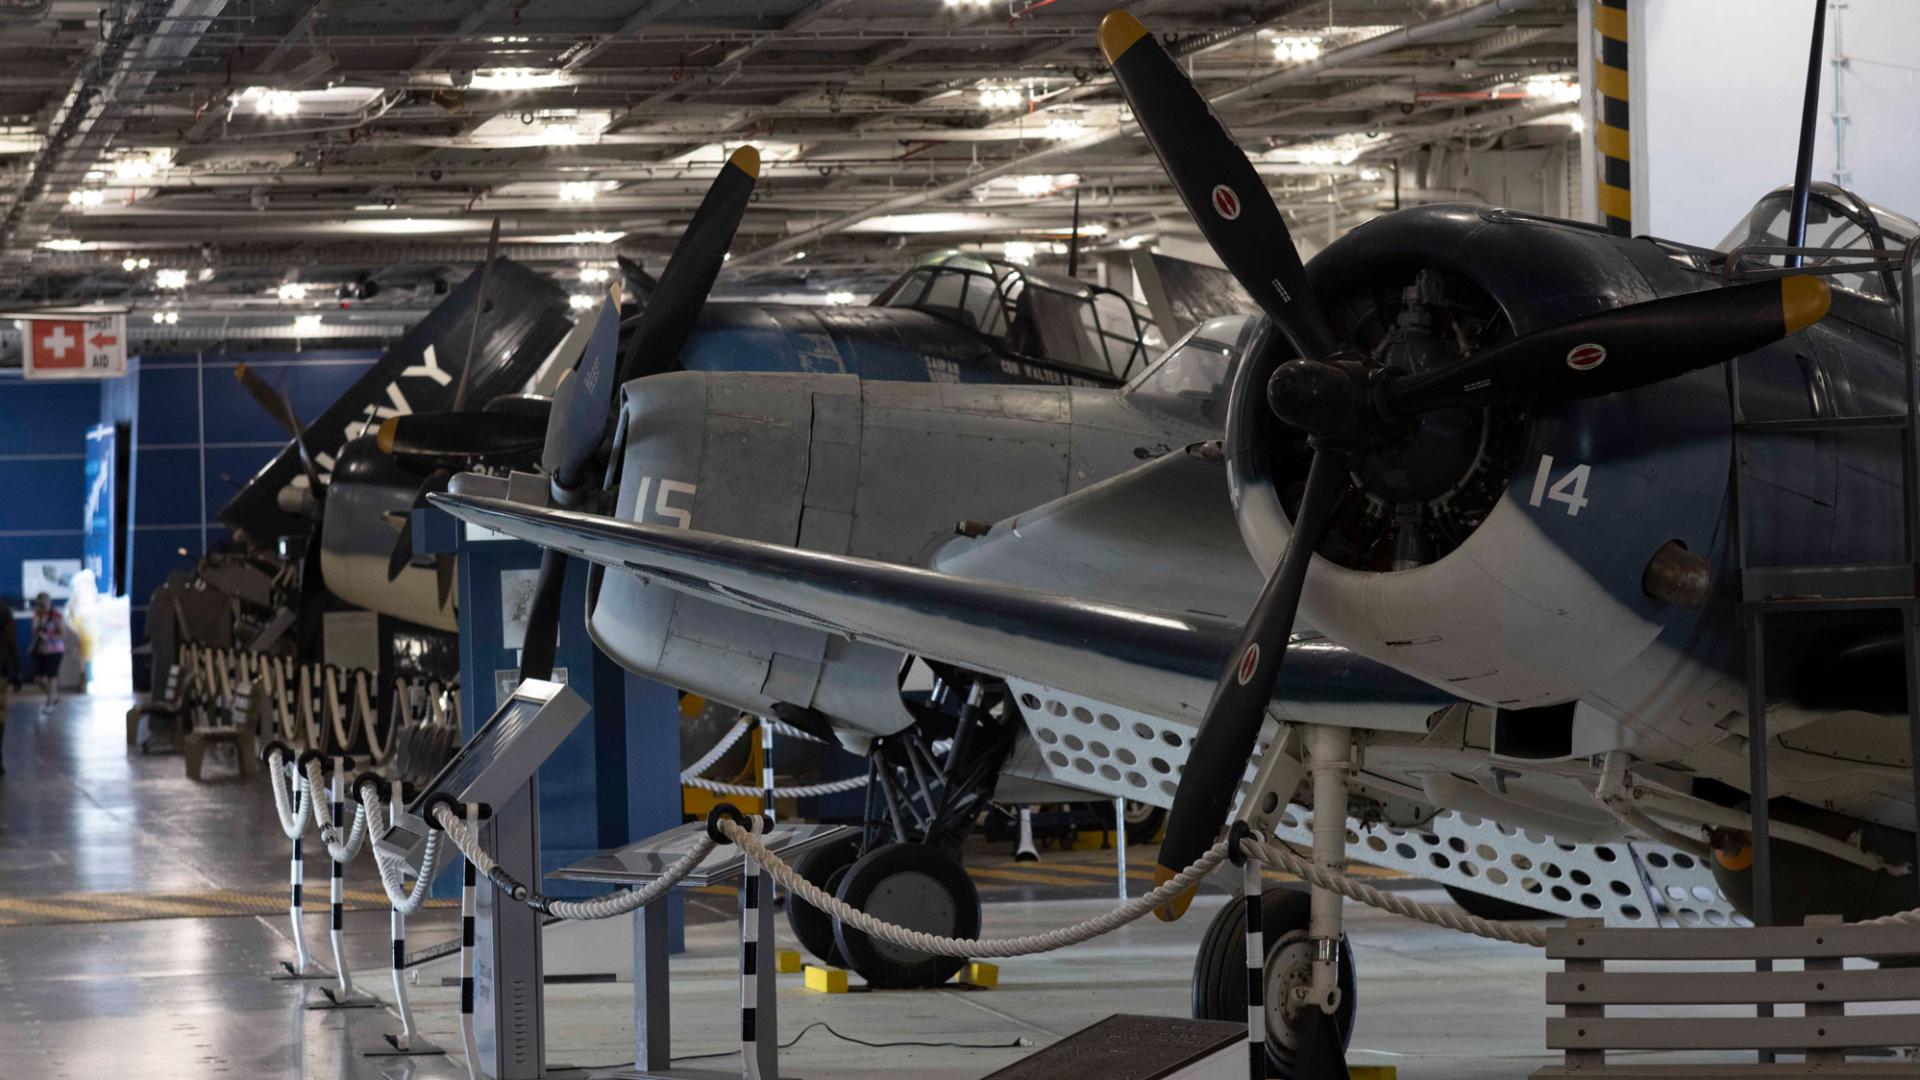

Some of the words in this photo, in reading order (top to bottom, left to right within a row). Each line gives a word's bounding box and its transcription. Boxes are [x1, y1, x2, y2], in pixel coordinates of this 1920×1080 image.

[92, 354, 110, 369] AID
[633, 476, 697, 530] 15
[1529, 454, 1592, 517] 14
